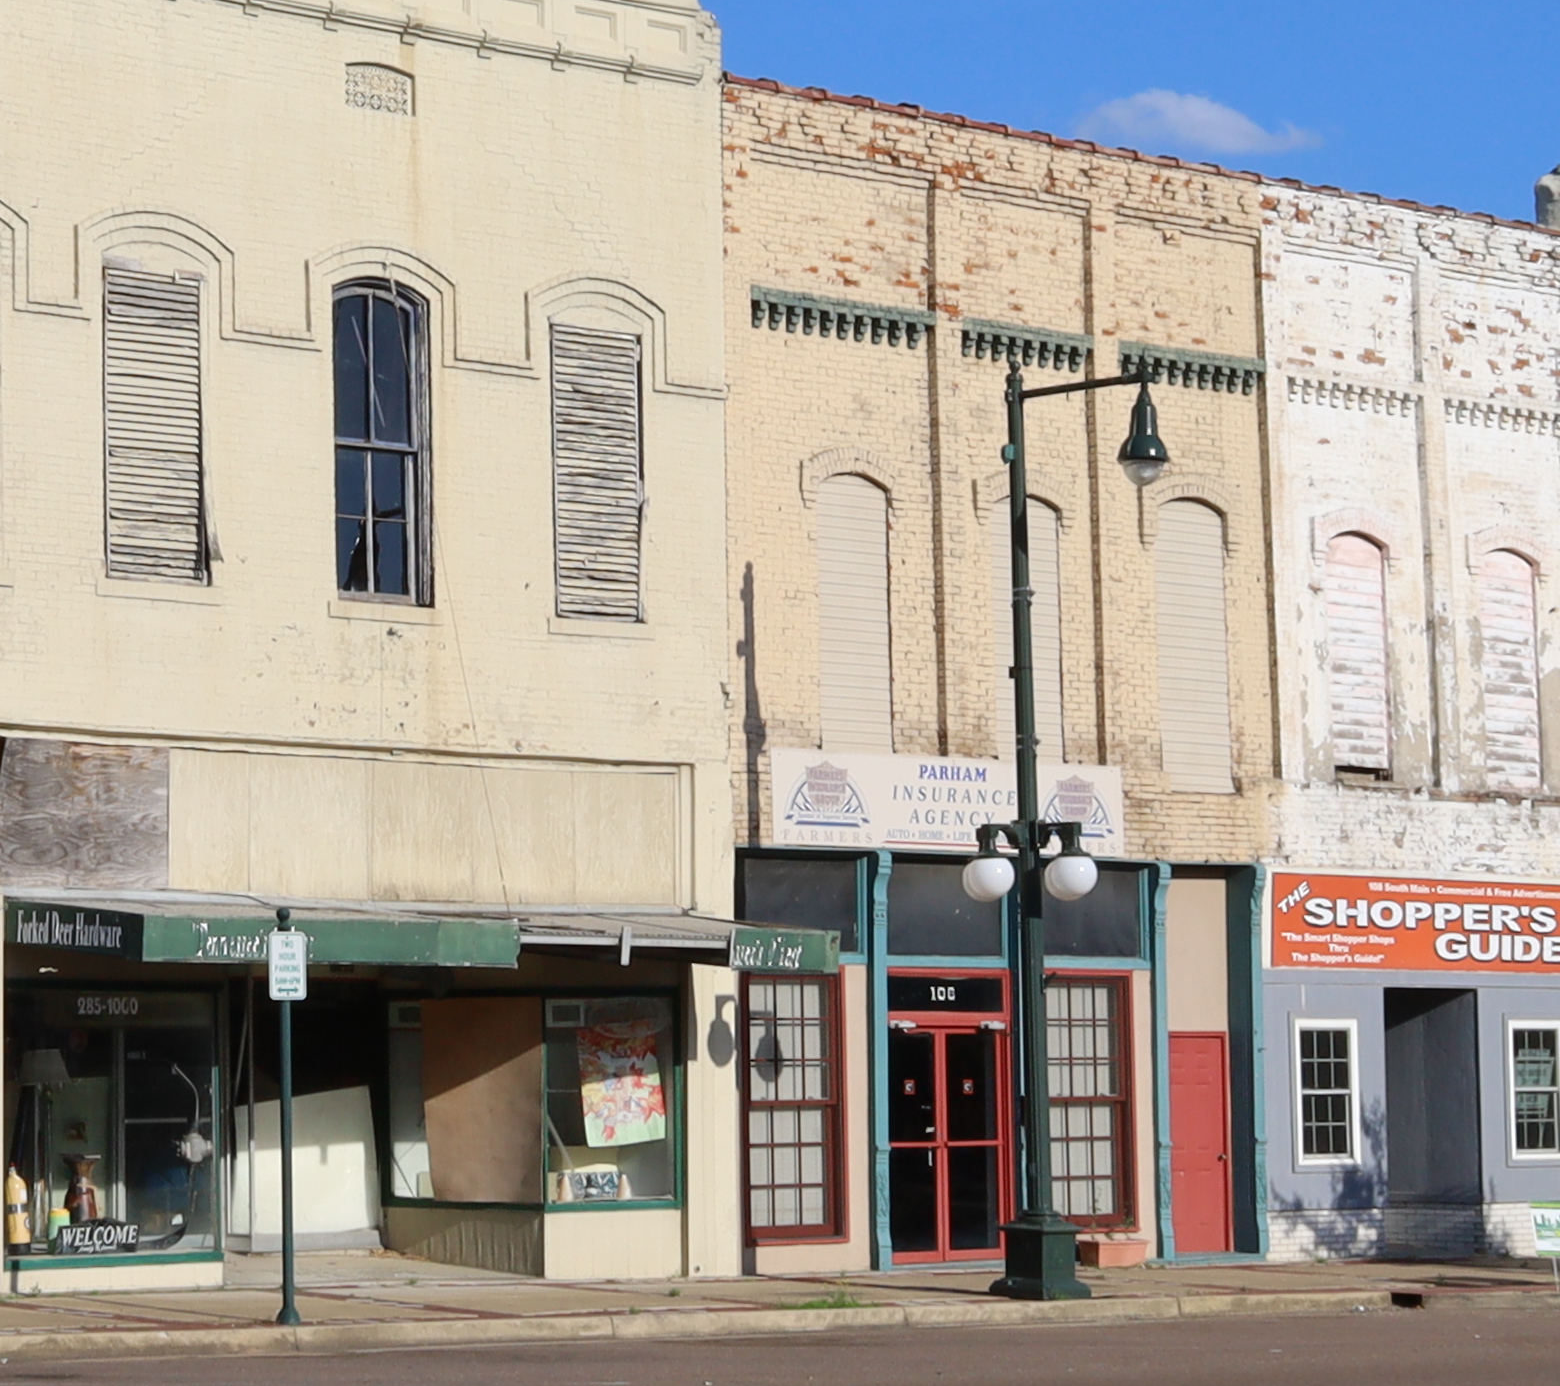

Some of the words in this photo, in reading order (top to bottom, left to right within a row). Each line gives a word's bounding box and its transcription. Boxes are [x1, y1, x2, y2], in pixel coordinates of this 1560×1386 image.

[919, 764, 987, 782] PARHAM
[892, 785, 1017, 806] INSURANCE
[909, 808, 996, 827] AGENCY
[783, 829, 873, 845] FARMERS
[886, 828, 911, 839] AUTO
[918, 830, 944, 841] HOME
[953, 832, 974, 842] LIFE
[1277, 881, 1311, 913] THE
[1436, 885, 1485, 897] Commercial
[1303, 897, 1557, 934] SHOPPER'S
[17, 909, 50, 944] Forked
[51, 910, 74, 946] Deer
[75, 912, 123, 949] Hardware
[281, 939, 295, 949] TWO
[278, 952, 297, 961] HOUR
[1292, 952, 1309, 962] The
[274, 964, 301, 973] PARKING
[61, 1224, 139, 1249] WELCOME
